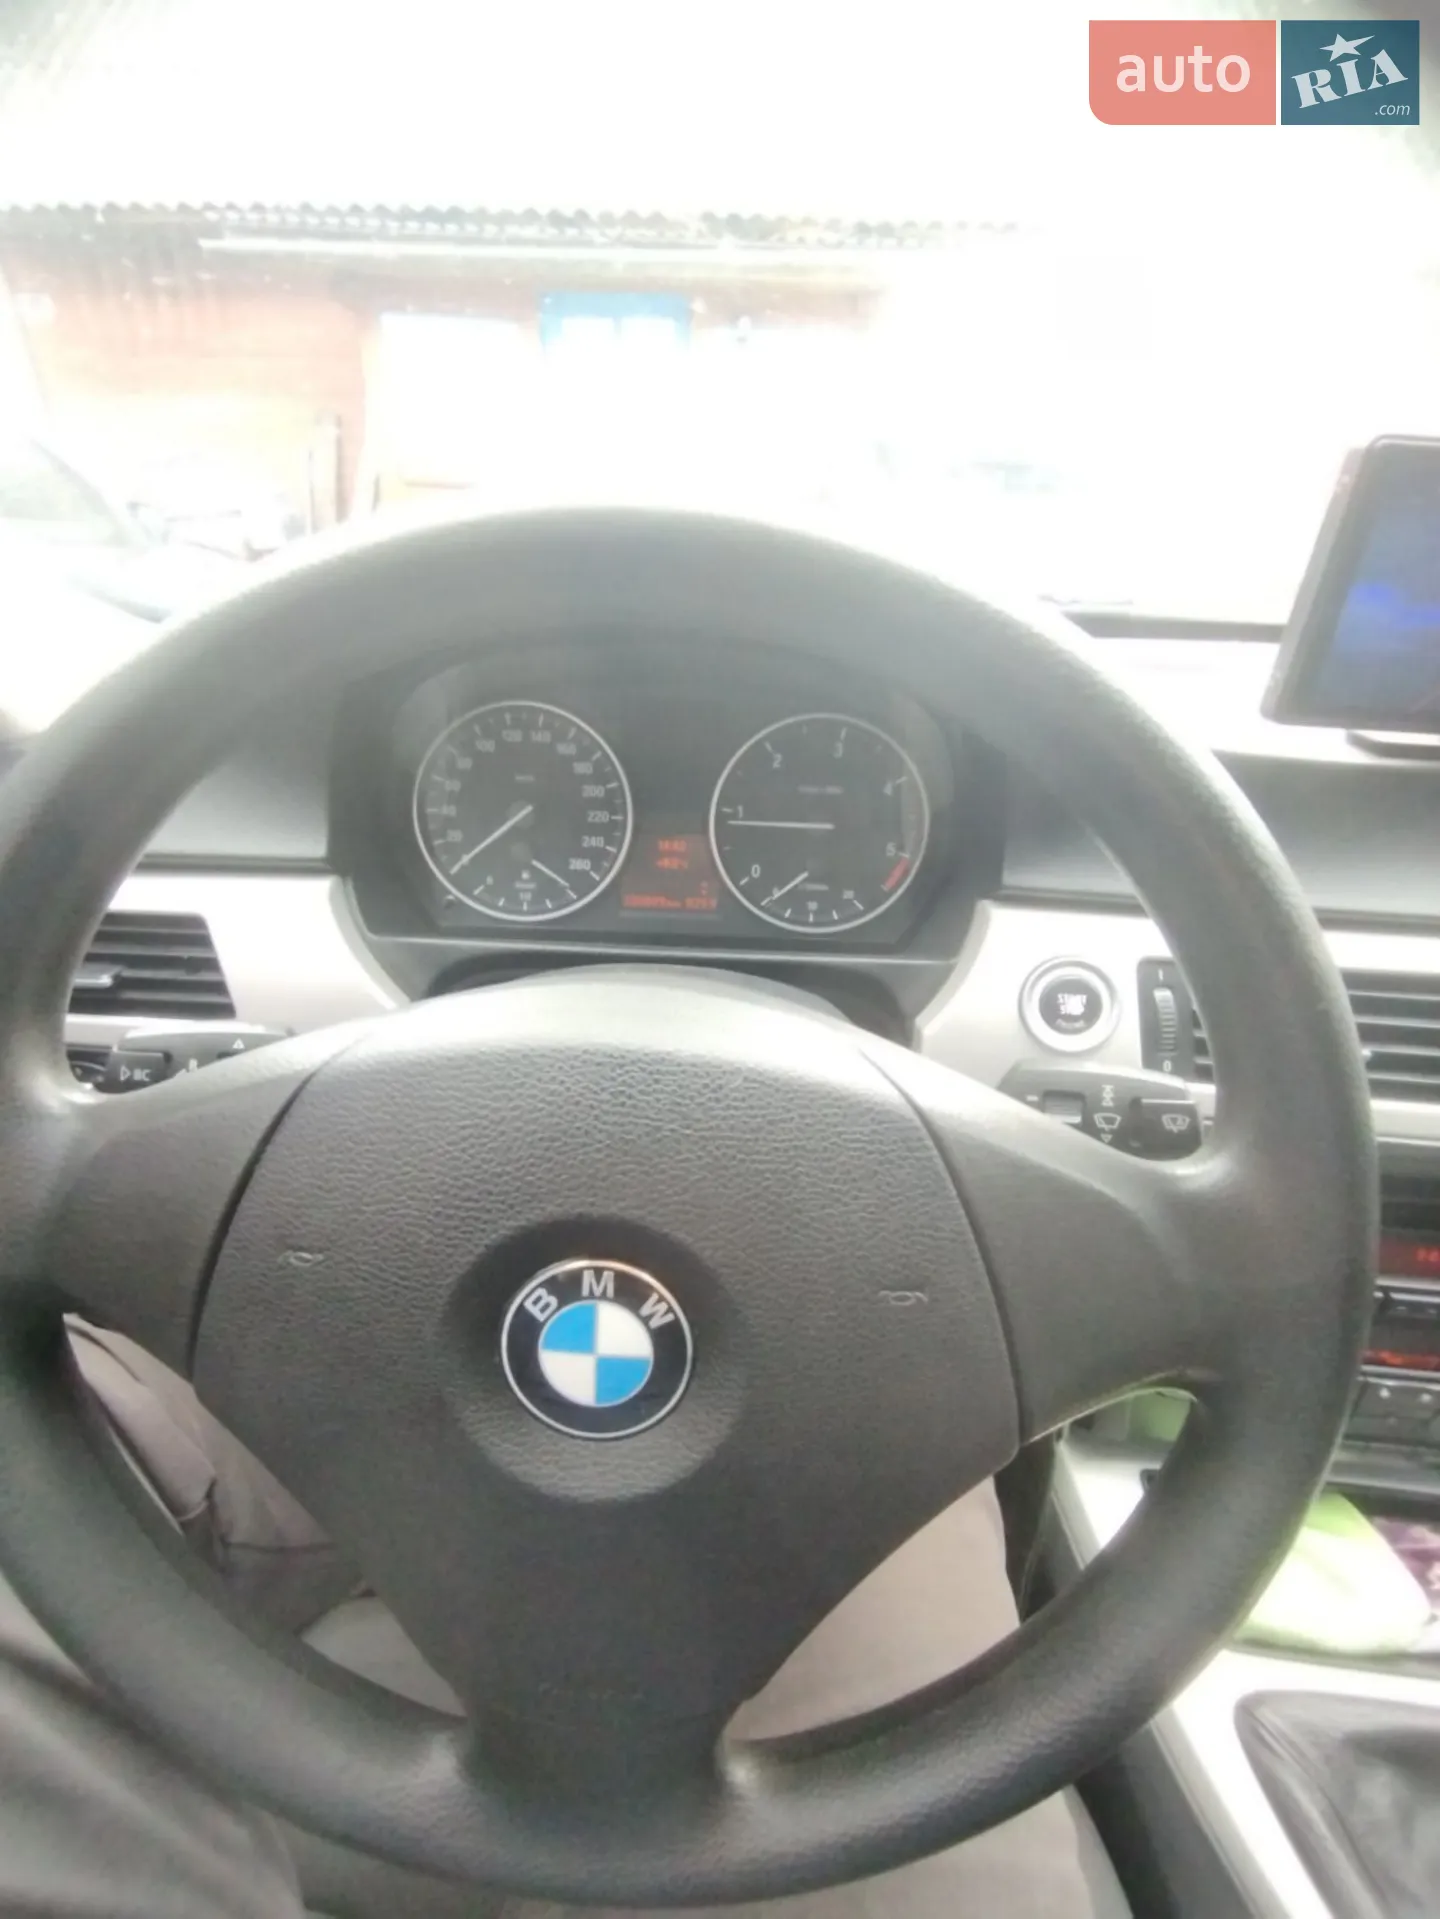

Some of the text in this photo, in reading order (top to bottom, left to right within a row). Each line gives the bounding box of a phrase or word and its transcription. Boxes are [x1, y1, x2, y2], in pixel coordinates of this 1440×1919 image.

[772, 754, 783, 768] 2
[587, 811, 609, 823] 220
[582, 835, 604, 848] 240
[568, 858, 591, 871] 260
[751, 864, 761, 878] 0
[523, 1269, 675, 1330] BMW
